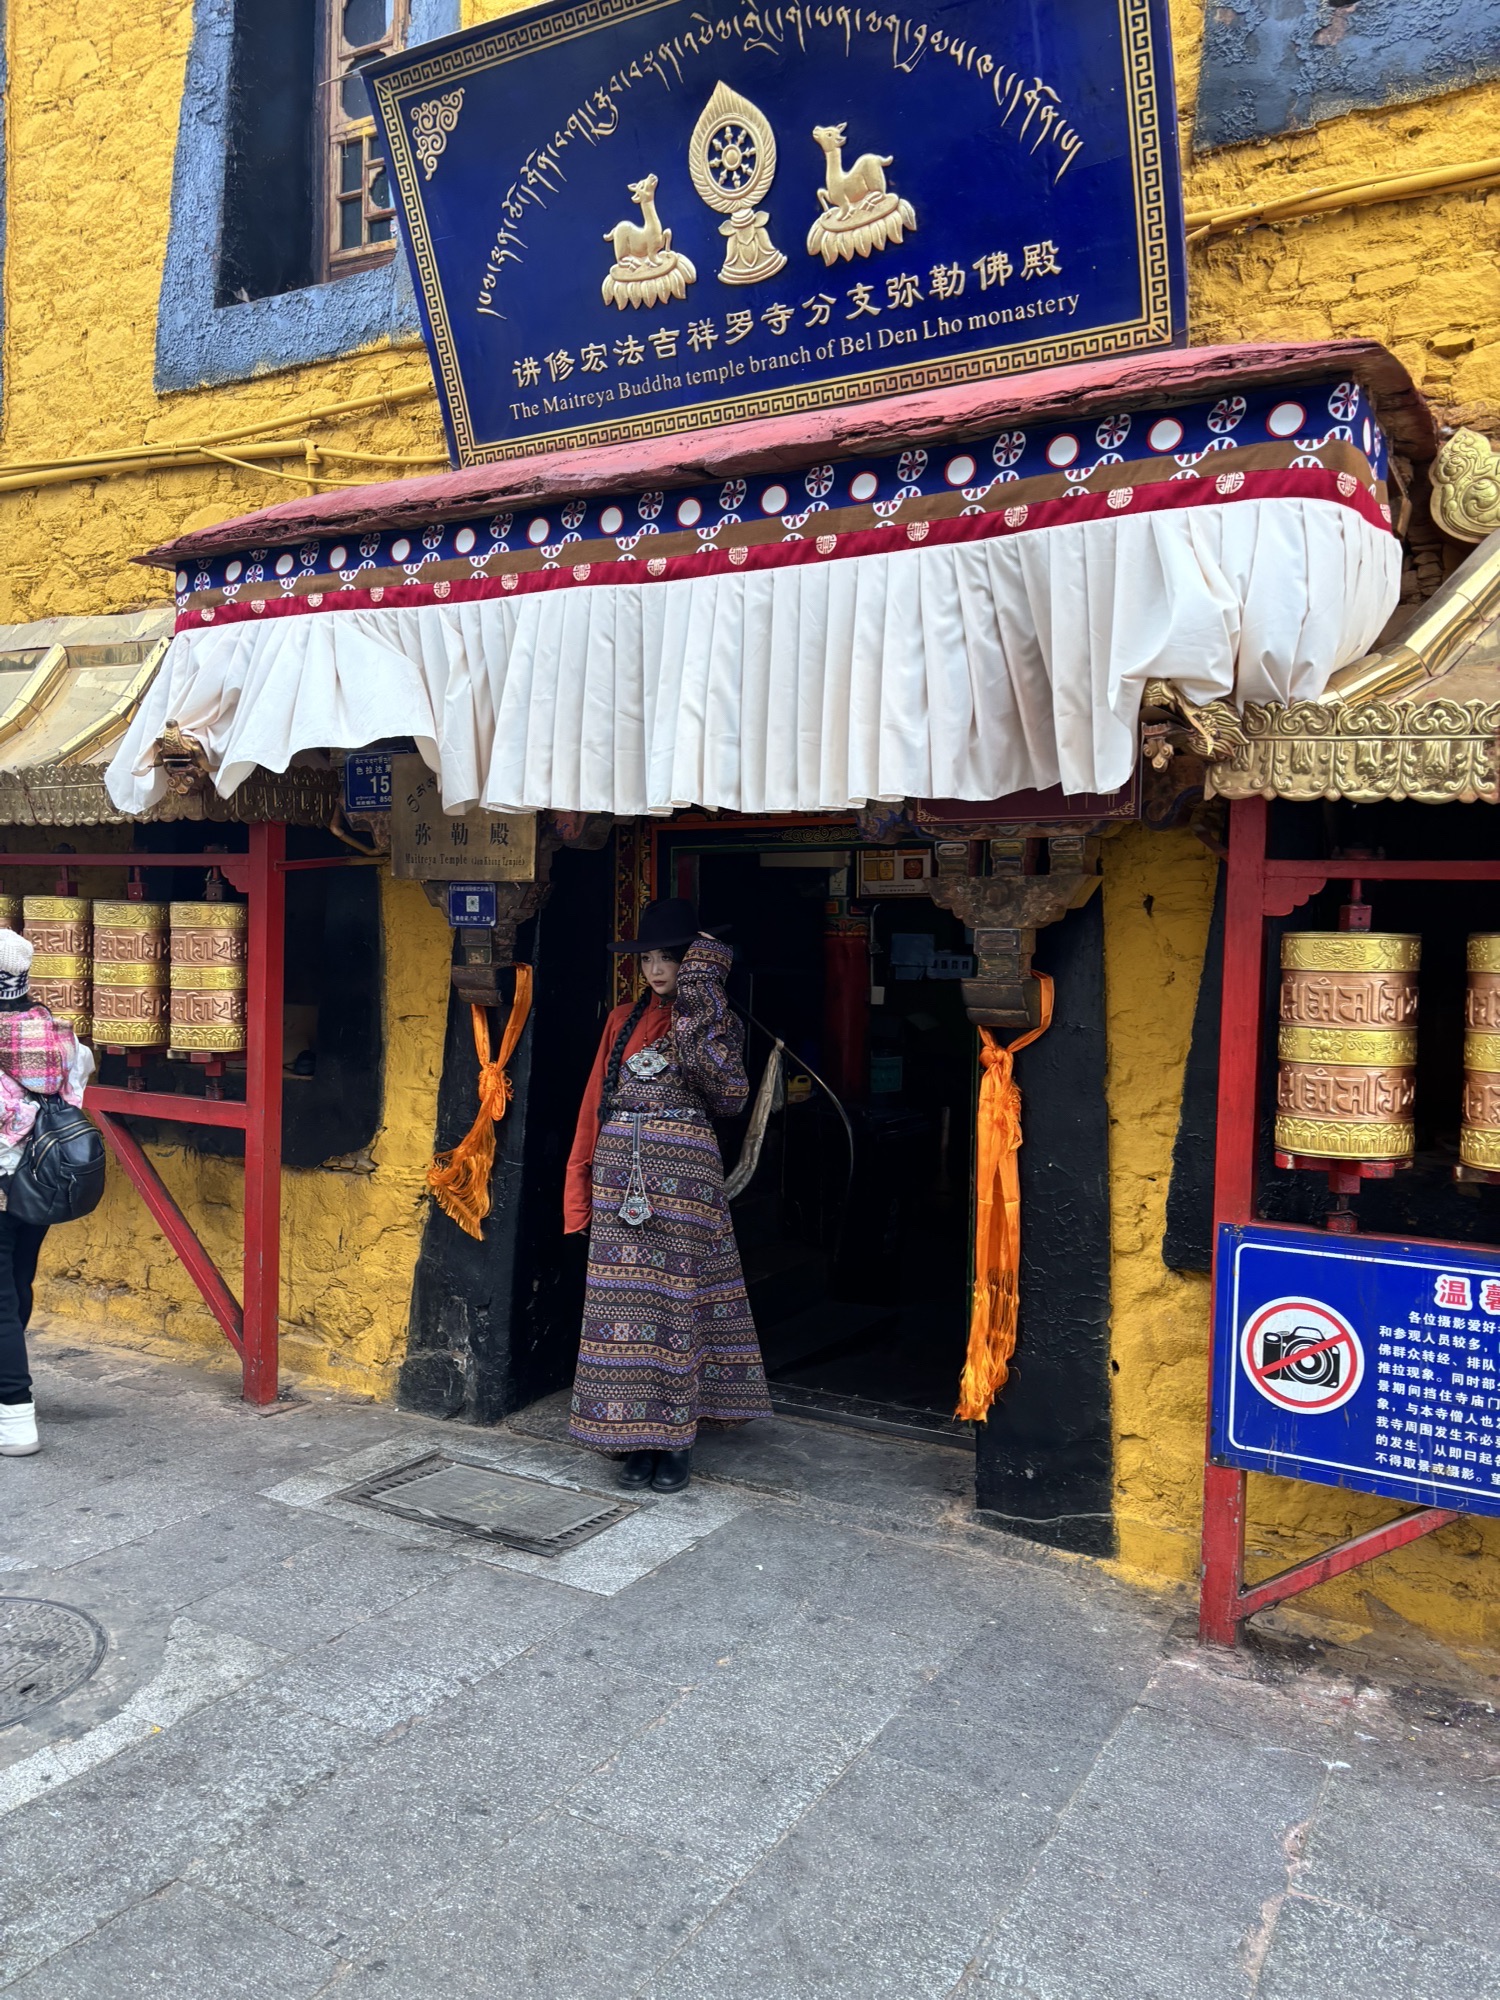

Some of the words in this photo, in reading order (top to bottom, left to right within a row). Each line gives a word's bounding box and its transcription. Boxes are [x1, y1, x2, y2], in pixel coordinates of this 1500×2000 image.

[511, 240, 1062, 388] 讲修宏法吉祥罗寺分支弥勒佛殿
[509, 402, 540, 420] The
[544, 388, 615, 416] Maitreya
[619, 373, 683, 399] Buddha
[685, 359, 745, 385] temple
[749, 343, 812, 374] branch
[816, 338, 836, 361] of
[840, 331, 873, 357] Bel
[878, 325, 919, 349] Den
[923, 315, 964, 340] Lho
[968, 293, 1081, 331] monastery
[370, 775, 390, 794] 15
[415, 822, 510, 846] 弥勒殿
[405, 852, 437, 866] Maitreya
[440, 853, 468, 867] Temple
[1408, 1310, 1500, 1335] 各位摄影爱好
[1378, 1325, 1500, 1353] 和参观人员较多，
[1378, 1342, 1500, 1375] 佛群众转经、排队
[1377, 1379, 1500, 1411] 景期间挡住寺庙门
